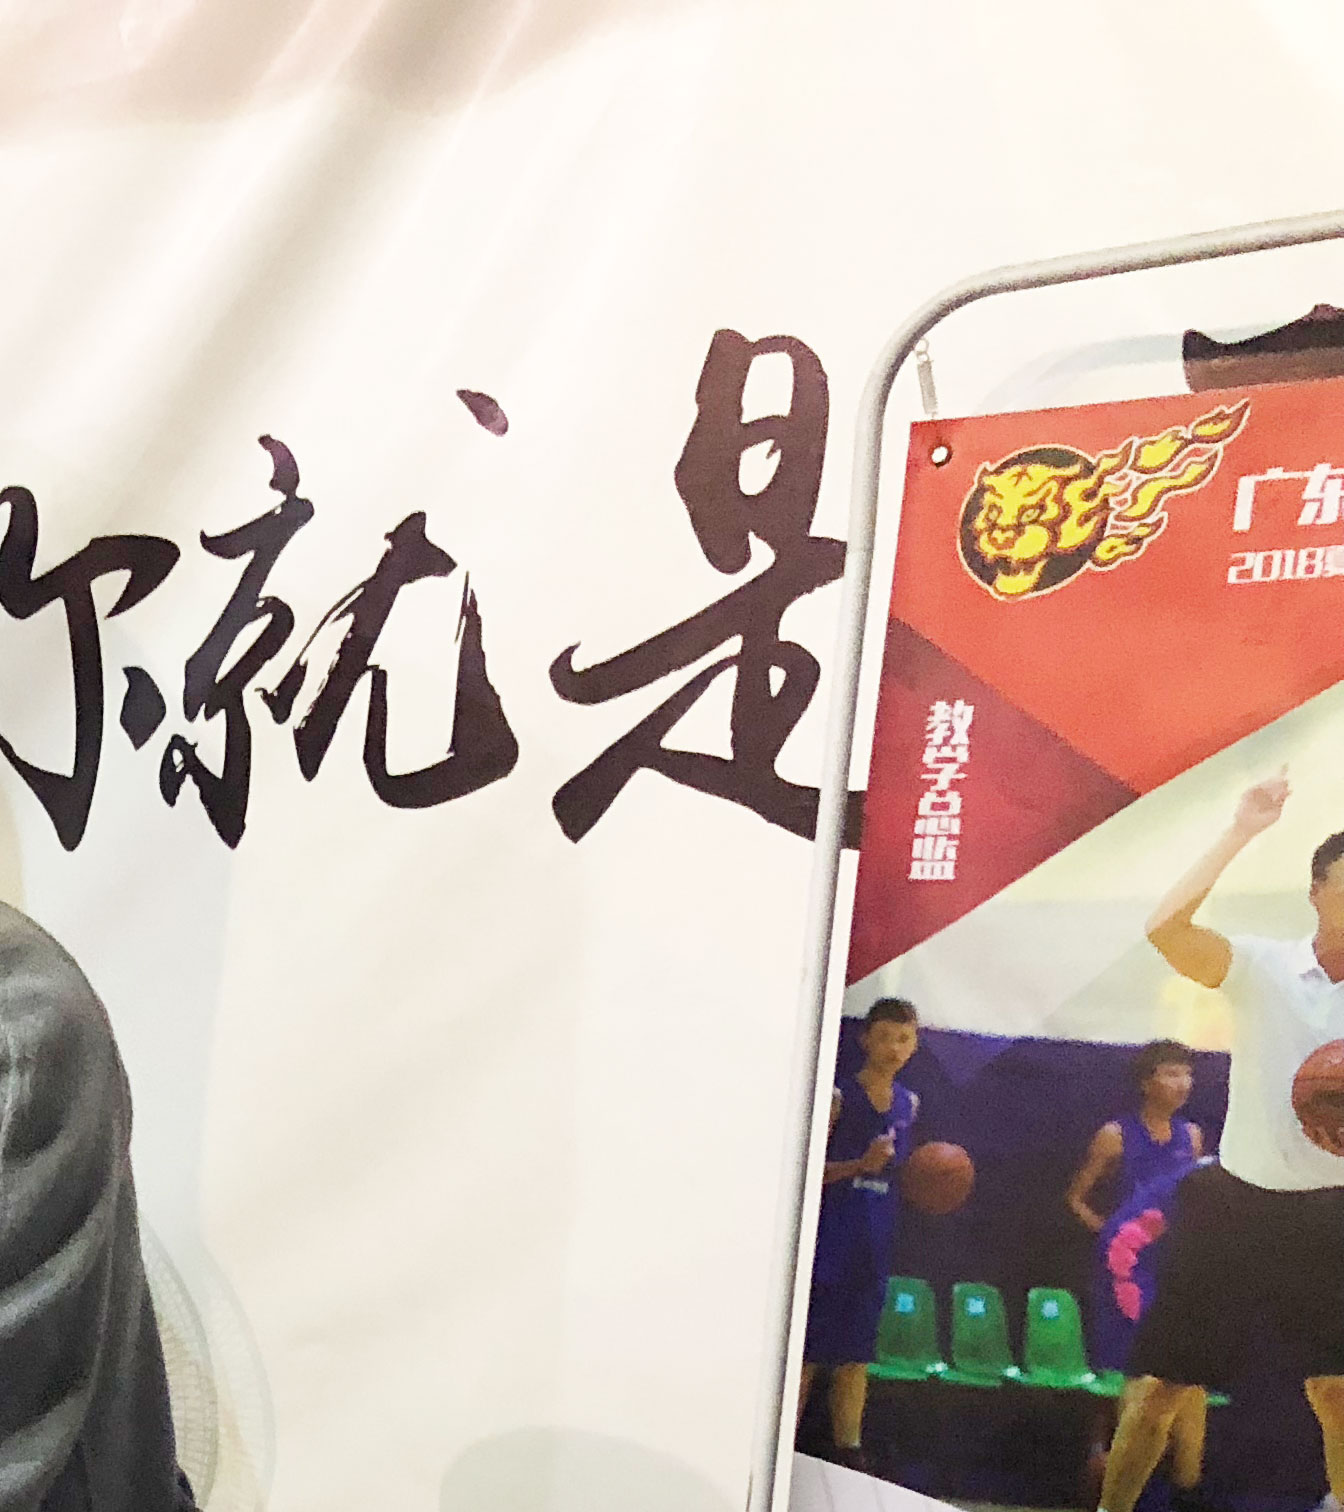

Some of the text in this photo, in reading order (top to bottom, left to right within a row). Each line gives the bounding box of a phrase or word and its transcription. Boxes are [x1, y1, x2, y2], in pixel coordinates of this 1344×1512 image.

[1226, 543, 1344, 585] 2018
[907, 699, 976, 881] 教学总监
